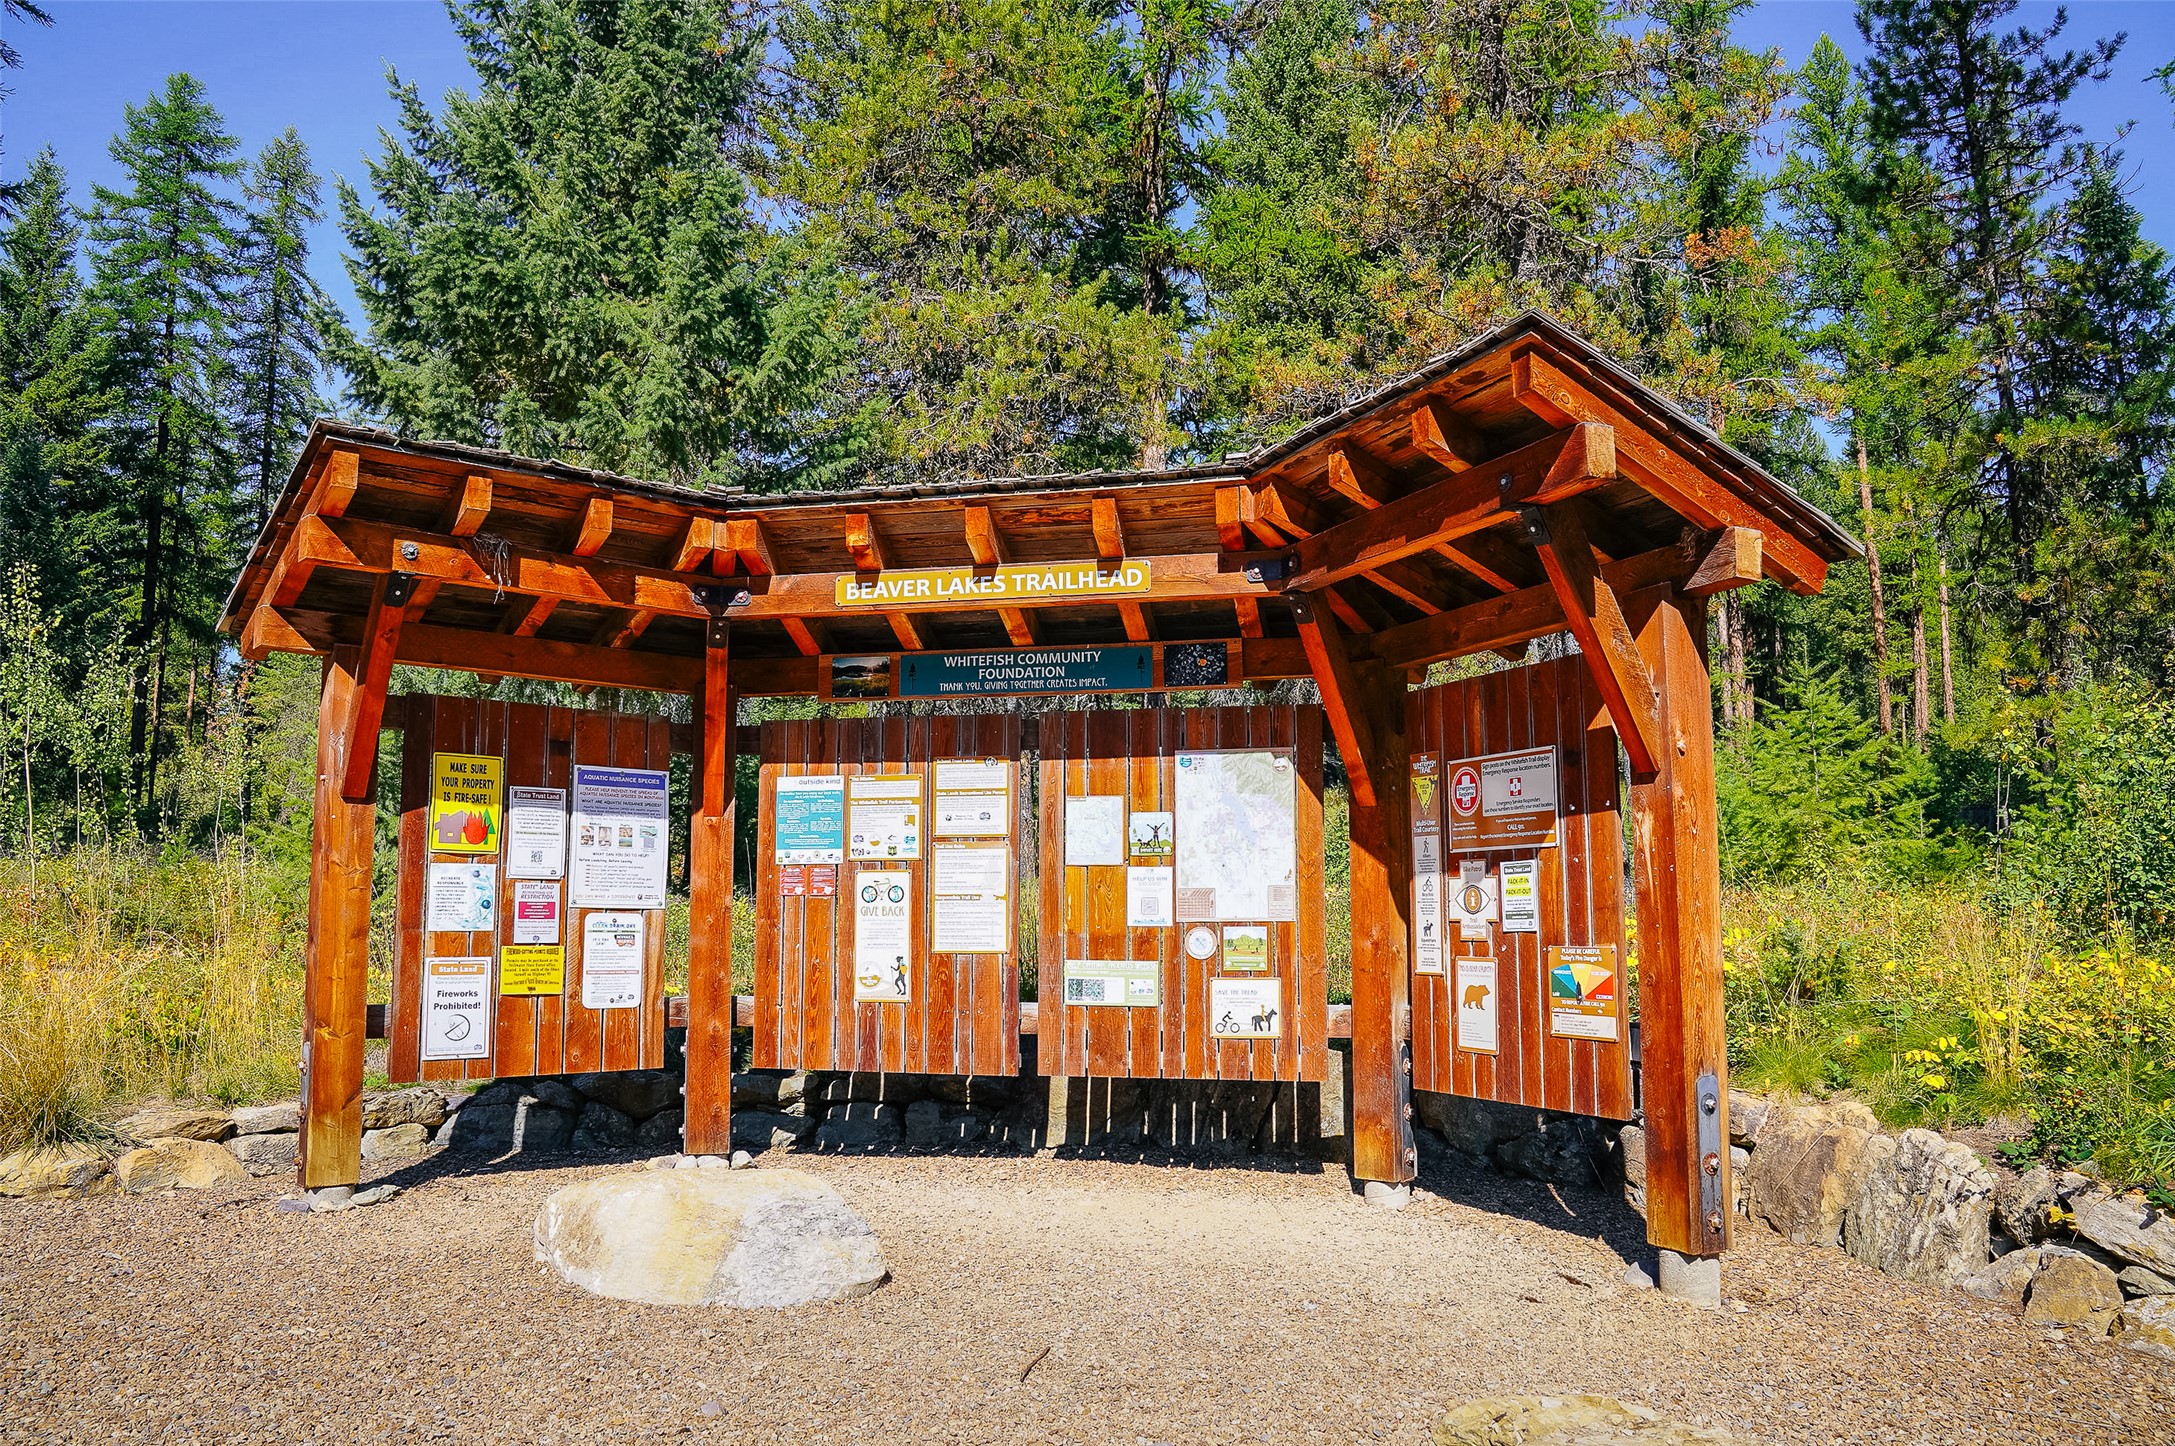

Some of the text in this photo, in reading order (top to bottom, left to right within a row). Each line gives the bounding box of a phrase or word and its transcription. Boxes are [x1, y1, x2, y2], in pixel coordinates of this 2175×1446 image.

[846, 568, 1143, 600] BEAVER LAKES TRAILHEAD
[944, 651, 1102, 668] WHITEFISH COMMUNITY
[978, 666, 1065, 680] FOUNDATION
[939, 677, 1108, 692] THANK YOU. GIVING TOGETHER CREATES IMPACT.
[450, 762, 487, 774] MAKE SURE
[441, 776, 494, 790] YOUR PROPERTY
[443, 791, 451, 802] IS
[1506, 888, 1531, 896] PACK-IT-OUT
[861, 906, 905, 917] GIVE BACK
[460, 965, 477, 973] Land
[436, 990, 479, 998] Fireworks
[433, 1002, 481, 1011] Prohibited!
